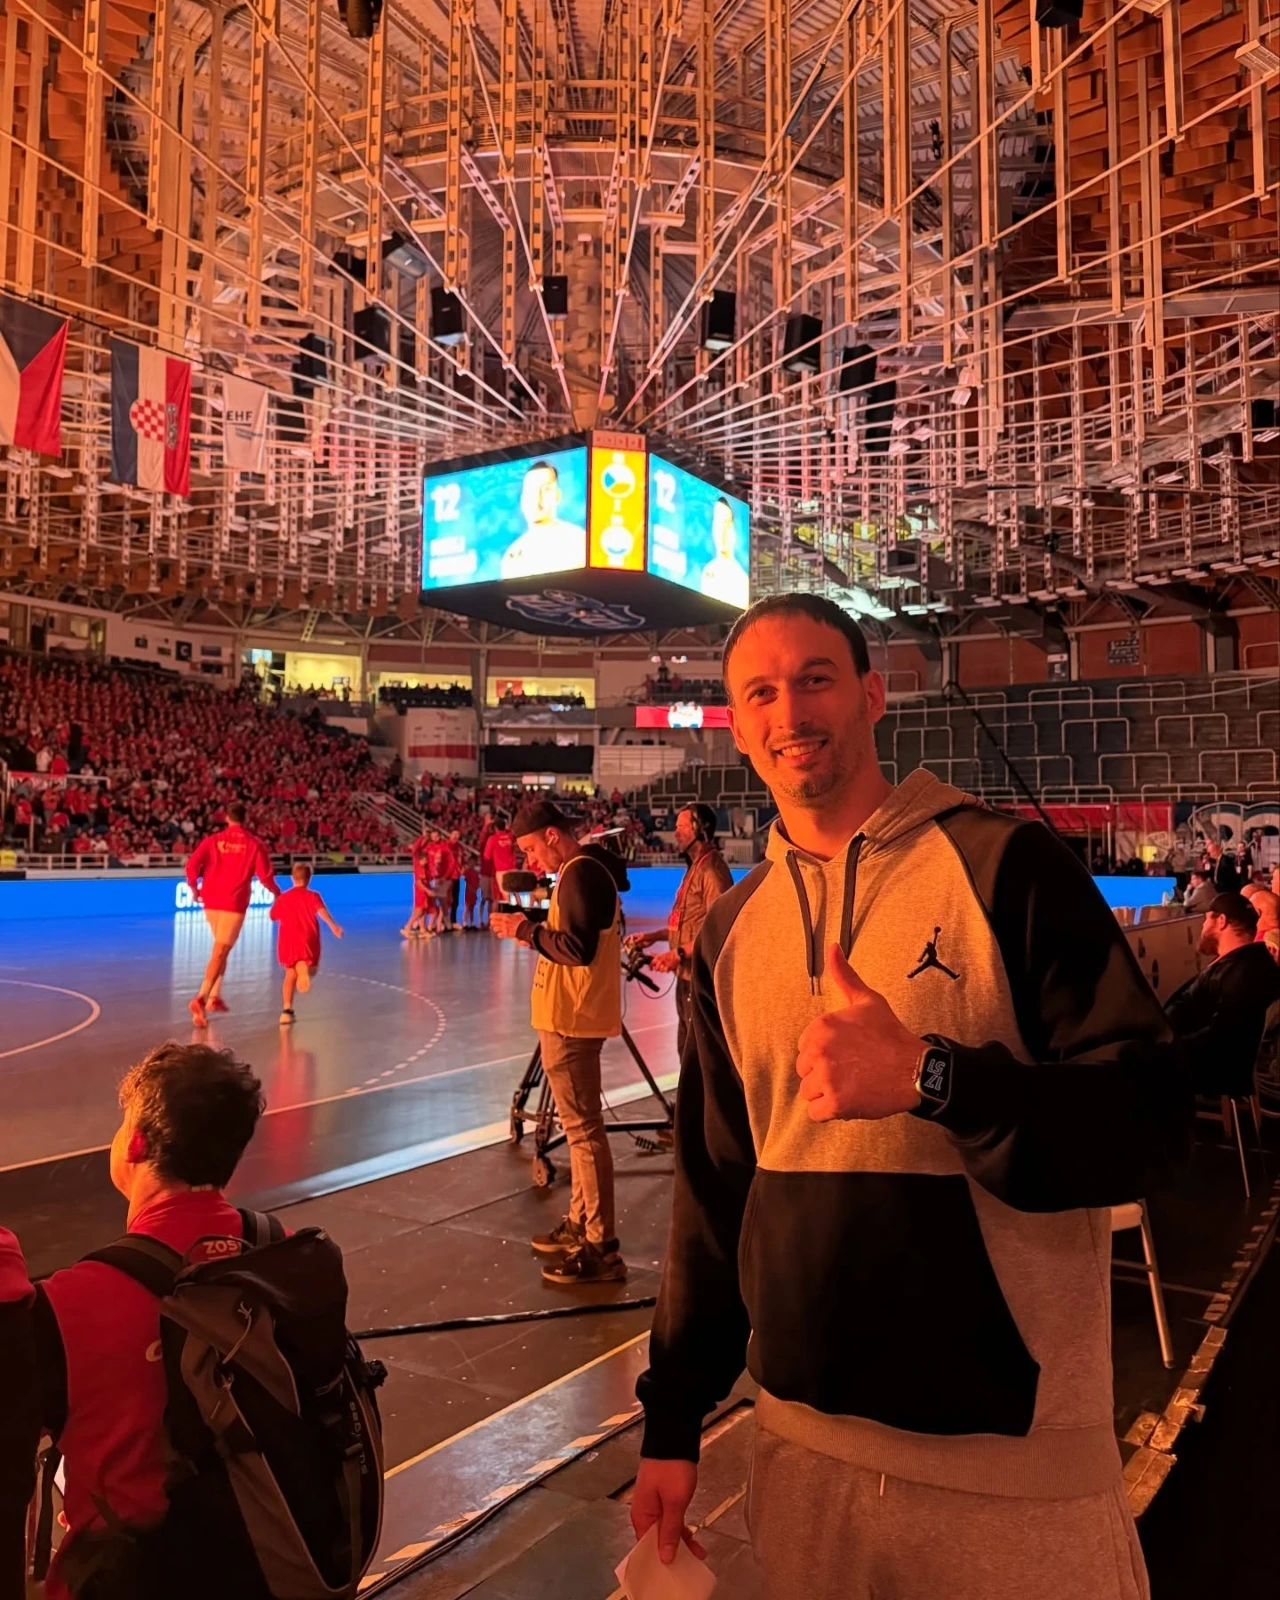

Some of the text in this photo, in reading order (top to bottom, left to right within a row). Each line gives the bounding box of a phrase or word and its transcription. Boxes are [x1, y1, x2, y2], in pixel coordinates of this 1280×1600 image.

[226, 410, 253, 421] EHF
[653, 469, 676, 513] 12
[431, 483, 461, 522] 12
[926, 1058, 946, 1075] 51
[923, 1075, 943, 1091] 17
